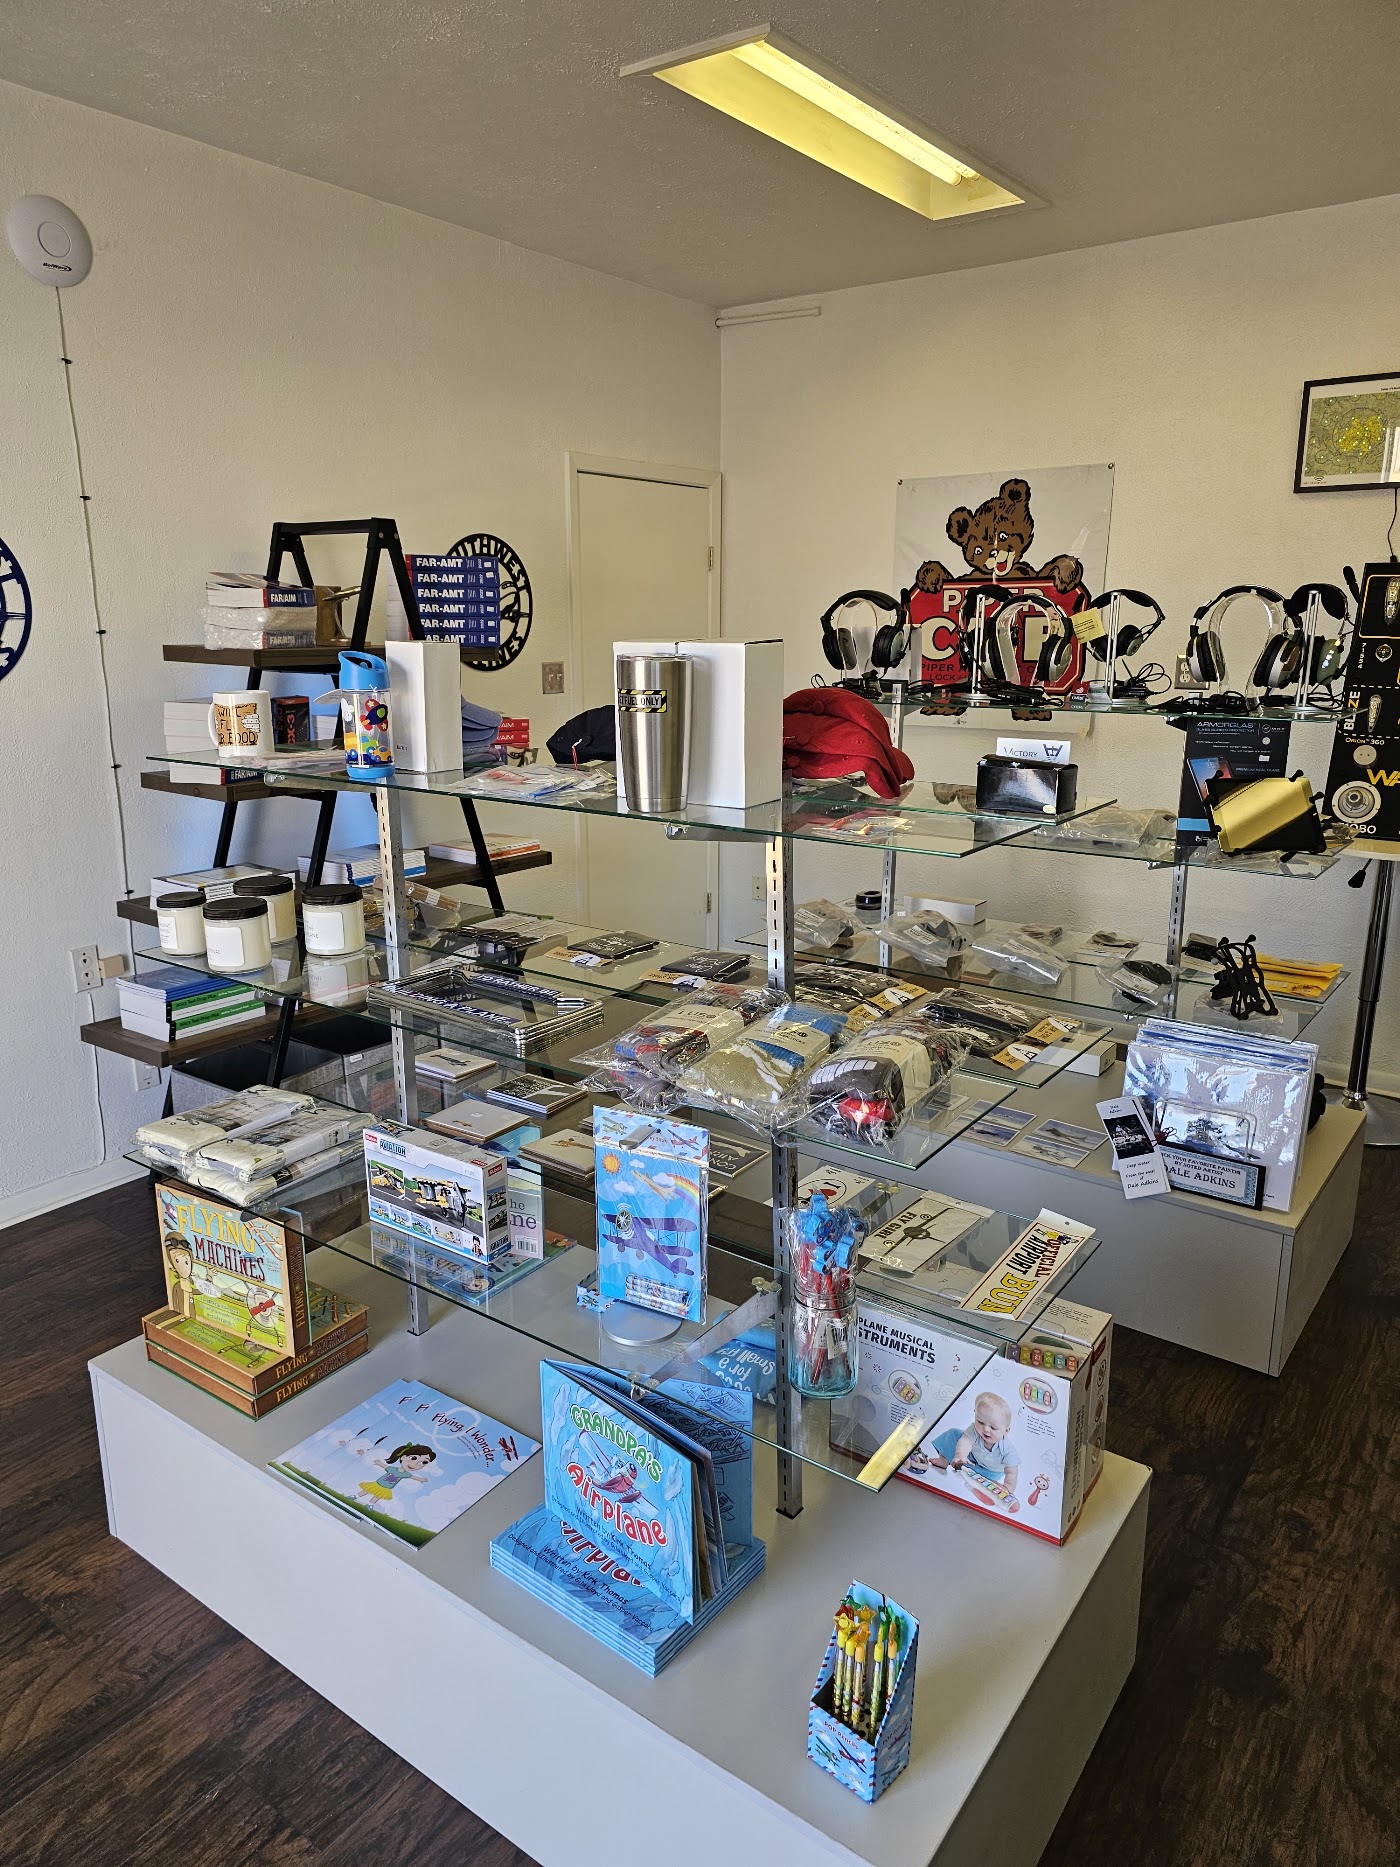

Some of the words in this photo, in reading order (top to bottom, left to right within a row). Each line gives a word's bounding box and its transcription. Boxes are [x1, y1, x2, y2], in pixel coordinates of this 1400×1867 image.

[416, 558, 463, 568] FAR-AMT
[417, 574, 464, 583] FAR-AMT
[270, 594, 297, 603] FAR/AIM
[417, 589, 464, 598] FAR-AMT
[419, 604, 465, 613] FAR-AMT
[420, 619, 465, 628] FAR-AMT
[425, 634, 466, 644] AR-AMT
[930, 673, 956, 681] LOCK
[625, 696, 639, 706] FUEL
[641, 696, 660, 706] ONLY
[1172, 1154, 1187, 1162] YOUR
[1187, 1158, 1218, 1169] FAVORITE
[1183, 1162, 1202, 1171] NOTED
[1202, 1167, 1224, 1176] ARTIST
[1140, 1179, 1159, 1187] Adkins
[1165, 1164, 1191, 1179] DALE
[1194, 1172, 1236, 1189] ADKINS
[510, 1199, 525, 1210] he
[510, 1214, 537, 1230] ne
[900, 1211, 918, 1225] FLY
[176, 1204, 256, 1254] FLYING
[874, 1223, 902, 1239] GIRL
[193, 1235, 266, 1282] MACHINES
[1006, 1235, 1049, 1275] AIRPORT
[1035, 1239, 1061, 1278] OFFICIAL
[858, 1317, 889, 1334] PLANE
[890, 1328, 936, 1351] MUSICAL
[858, 1327, 937, 1364] STRUMENTS
[276, 1353, 309, 1379] FLYING
[736, 1349, 776, 1375] Small
[729, 1366, 752, 1381] for
[276, 1376, 309, 1402] FLYING
[465, 1426, 475, 1434] I
[570, 1404, 664, 1483] GRANDPA'S
[566, 1461, 668, 1547] Airplane
[543, 1545, 572, 1569] Written
[571, 1565, 582, 1576] by
[581, 1571, 599, 1586] Kirk
[599, 1582, 629, 1606] Thomas
[601, 1594, 612, 1604] and
[824, 1720, 837, 1733] POP
